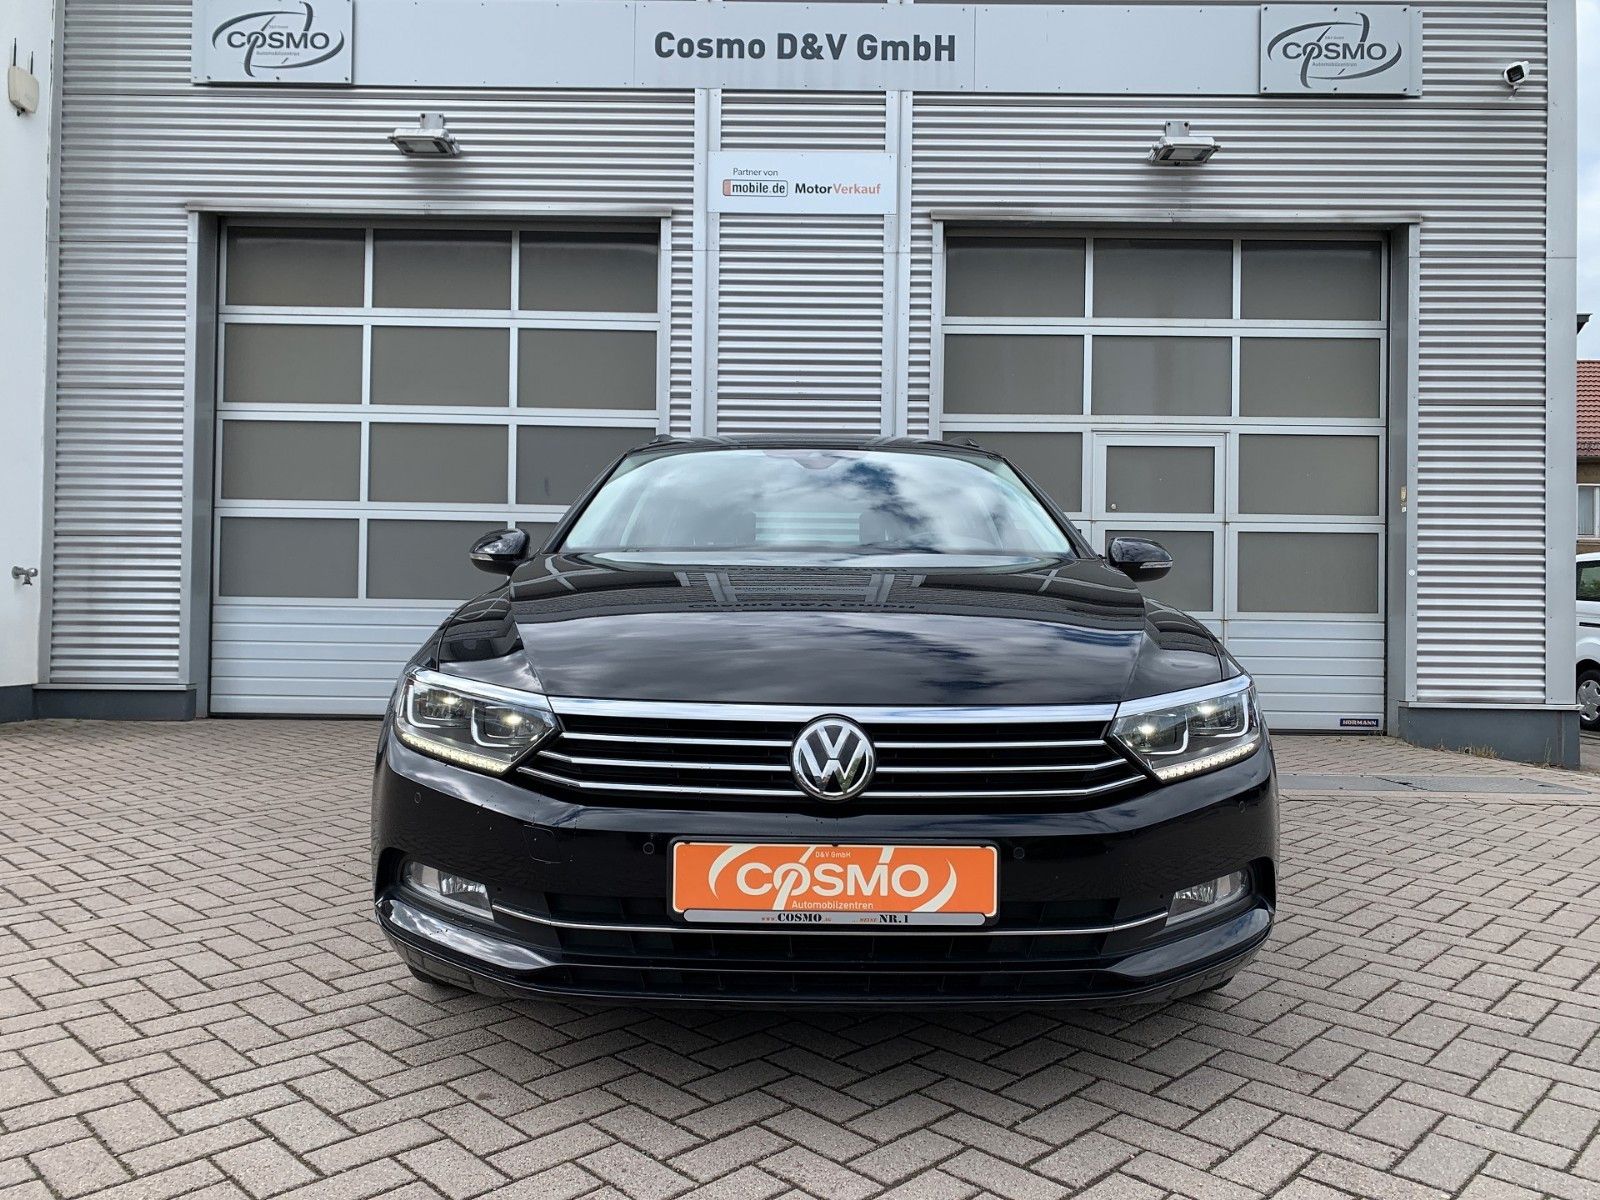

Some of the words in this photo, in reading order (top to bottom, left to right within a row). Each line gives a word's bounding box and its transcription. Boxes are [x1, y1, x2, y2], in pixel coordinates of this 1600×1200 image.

[227, 31, 329, 50] COSMO
[654, 31, 766, 60] Cosmo
[776, 32, 848, 61] D&V
[856, 33, 956, 62] GmbH
[1282, 42, 1387, 60] COSMO
[732, 167, 762, 177] Partner
[763, 170, 779, 178] von
[731, 182, 786, 195] mobile.de
[795, 719, 872, 797] VW
[815, 851, 829, 859] D&V
[831, 851, 851, 859] GmbH
[735, 861, 930, 898] COSMO
[791, 900, 874, 911] Automobilzentren
